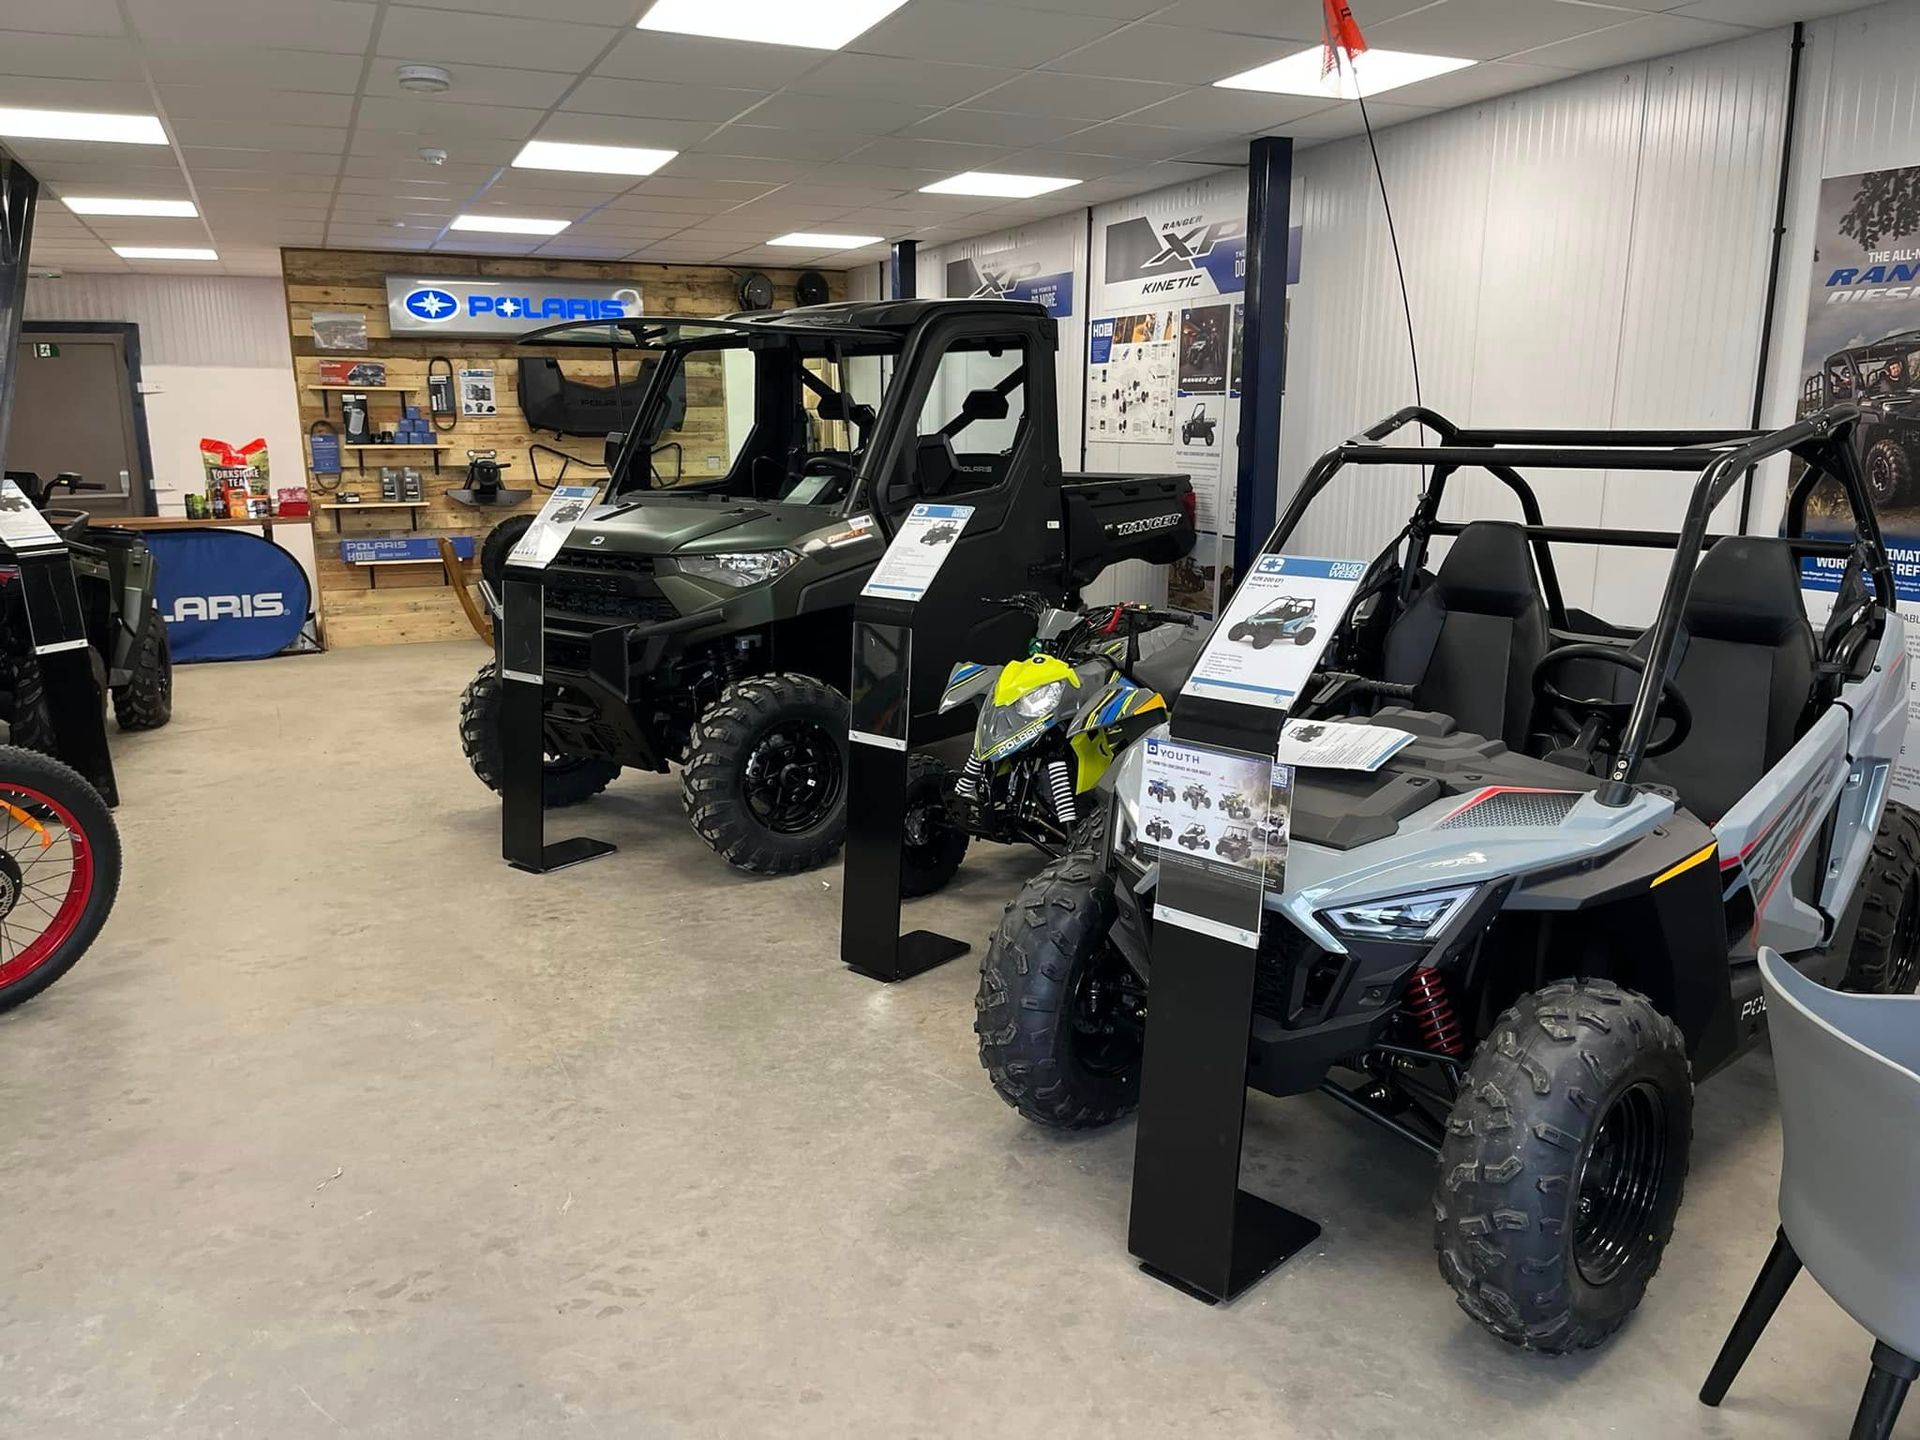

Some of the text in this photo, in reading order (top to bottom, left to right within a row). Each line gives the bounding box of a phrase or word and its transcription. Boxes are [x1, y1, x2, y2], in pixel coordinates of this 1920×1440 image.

[1162, 215, 1204, 230] RANGER
[1868, 250, 1890, 263] THE
[1141, 275, 1203, 295] KINETIC
[468, 295, 626, 320] POLARIS
[1117, 513, 1182, 536] RANGER
[346, 541, 407, 550] POLARIS
[1329, 569, 1361, 580] WEBB
[1331, 562, 1364, 572] DAVID
[998, 721, 1046, 755] POLARIS
[1160, 747, 1200, 764] YOUTH
